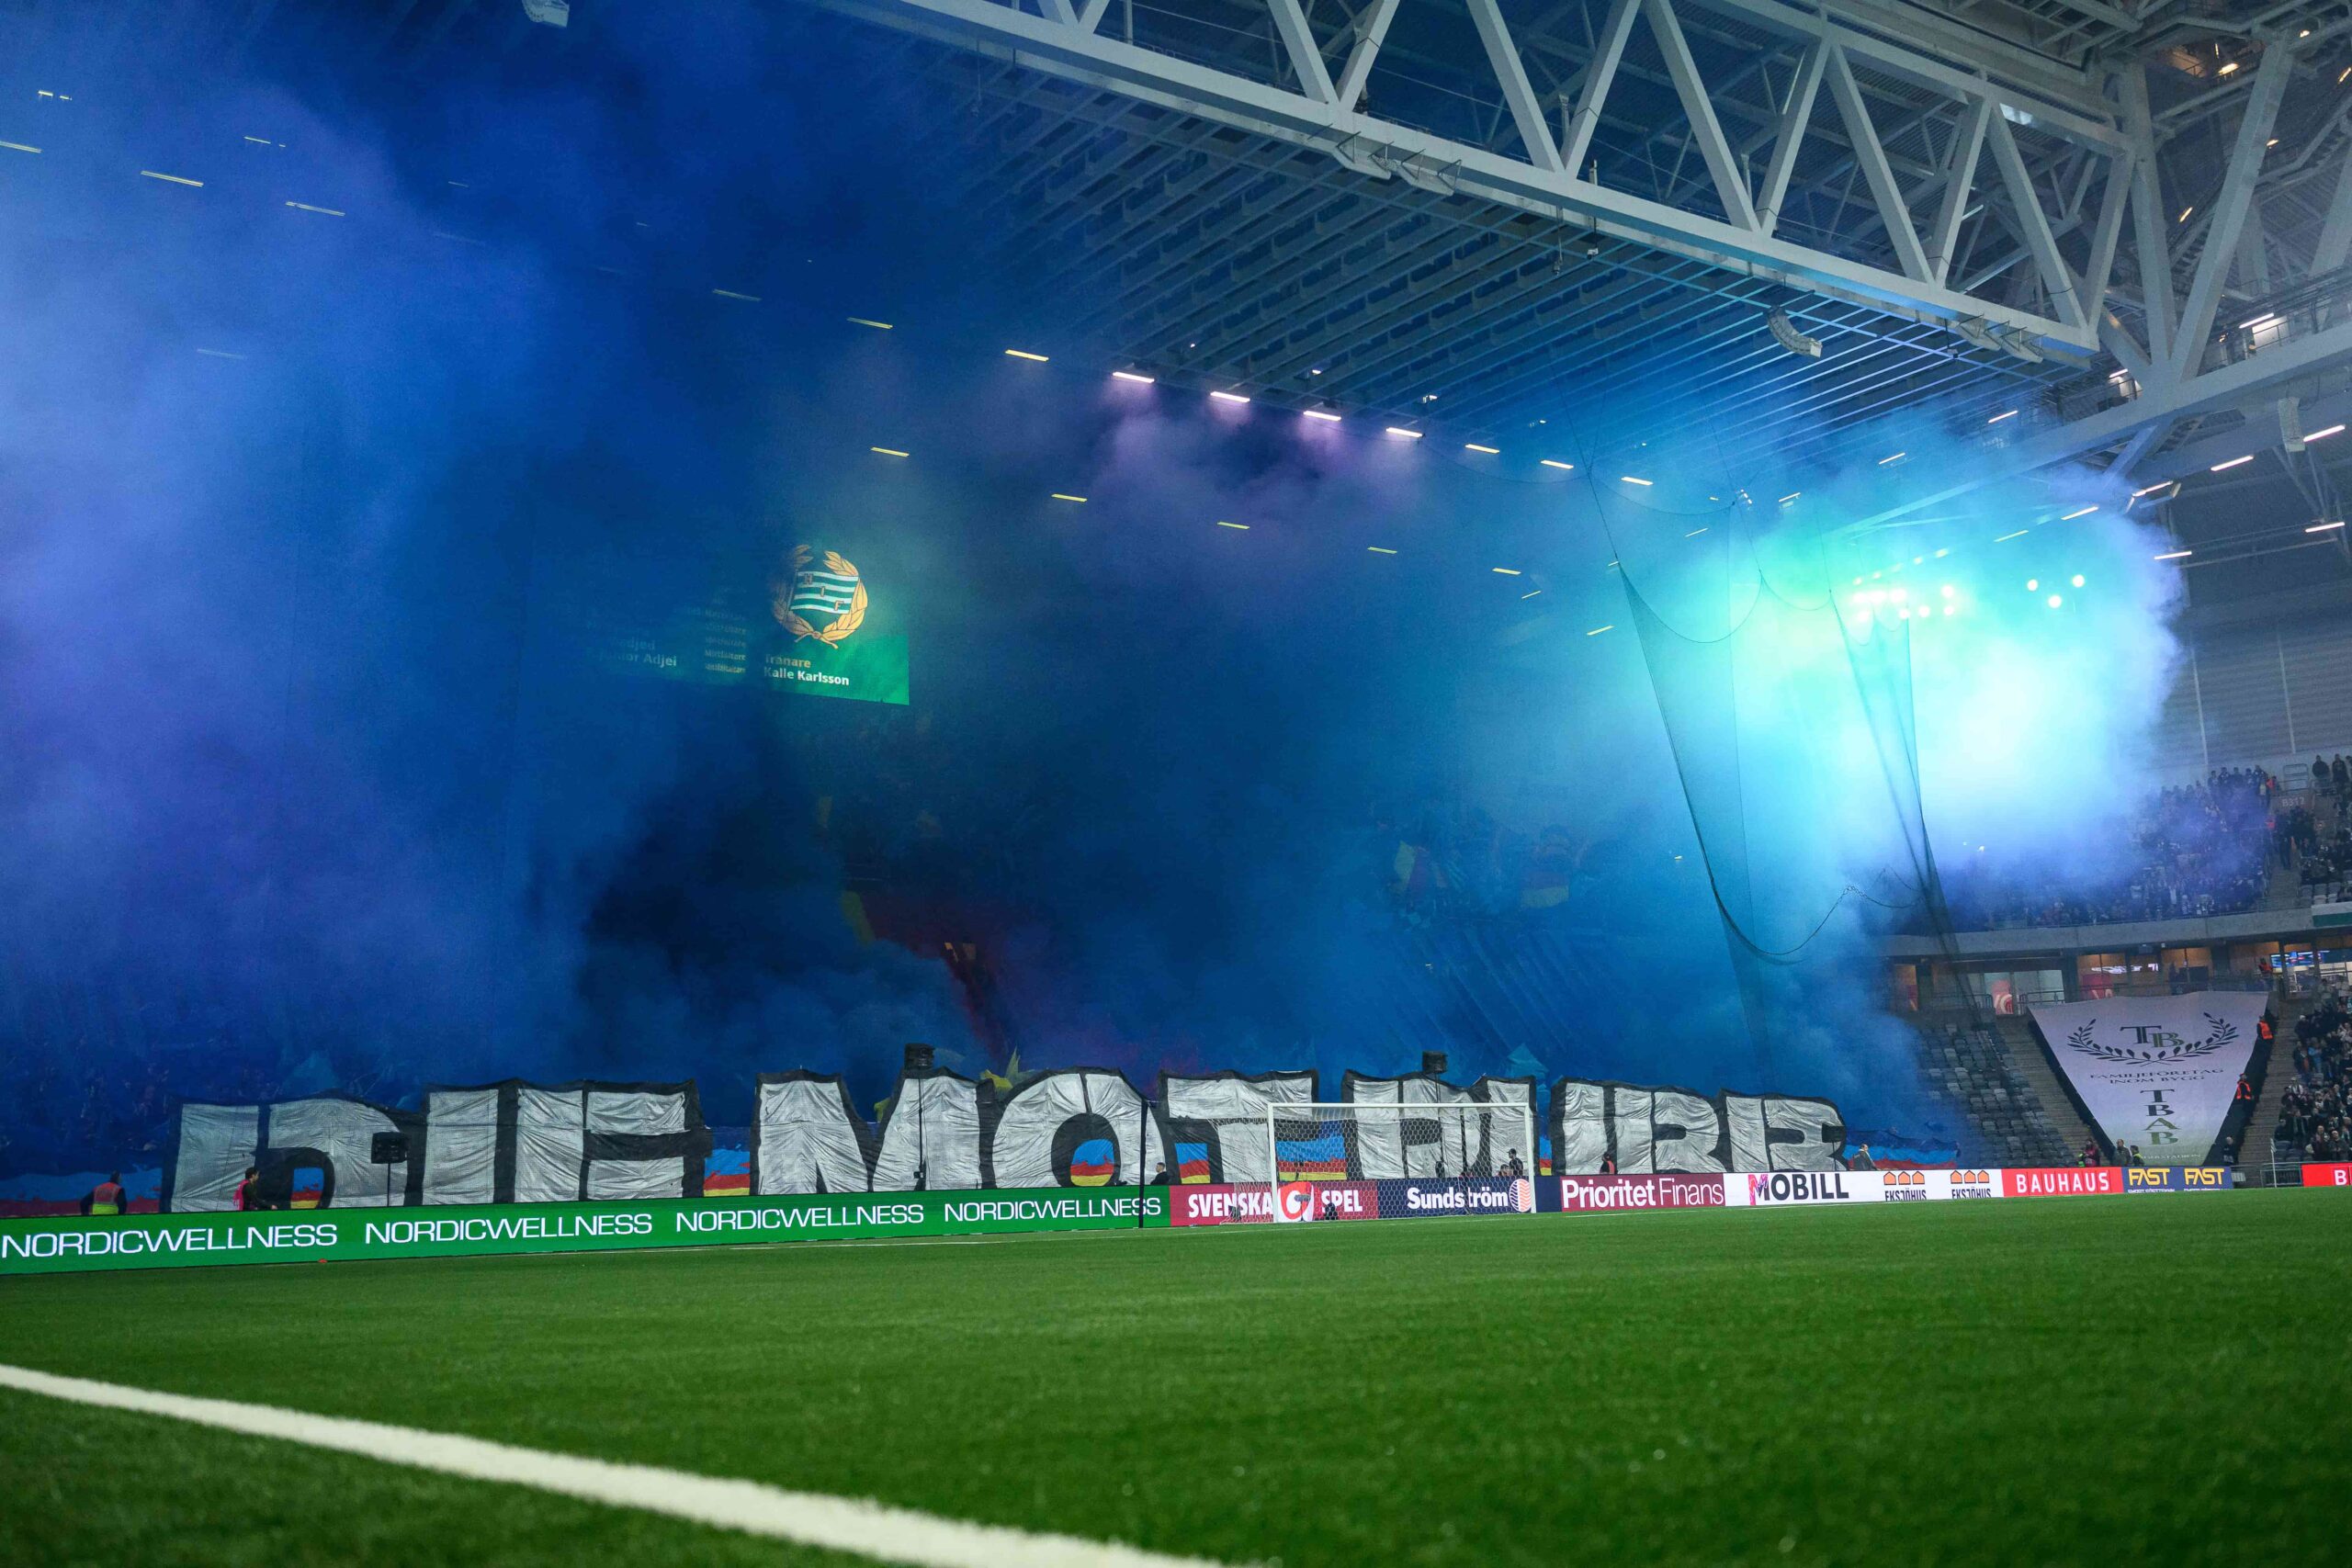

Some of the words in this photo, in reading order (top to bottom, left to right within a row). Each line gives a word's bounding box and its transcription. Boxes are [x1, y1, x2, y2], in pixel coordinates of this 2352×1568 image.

[643, 654, 677, 668] Adjei
[764, 667, 794, 680] Kalle
[797, 671, 850, 686] Karlsson
[2120, 1025, 2185, 1048] TB
[2016, 1172, 2109, 1194] BAUHAUS
[2128, 1168, 2170, 1186] FAST
[2184, 1168, 2224, 1186] FAST
[1407, 1187, 1508, 1210] Sundström
[1563, 1178, 1657, 1208] Prioritet
[1659, 1177, 1724, 1206] Finans
[1748, 1174, 1849, 1205] MOBILL
[944, 1198, 1160, 1223] NORDICWELLNESS
[1188, 1192, 1273, 1218] SVENSKA
[1321, 1190, 1363, 1213] SPEL
[366, 1213, 652, 1245] NORDICWELLNESS
[675, 1204, 923, 1233] NORDICWELLNESS
[3, 1224, 337, 1258] NORDICWELLNESS
